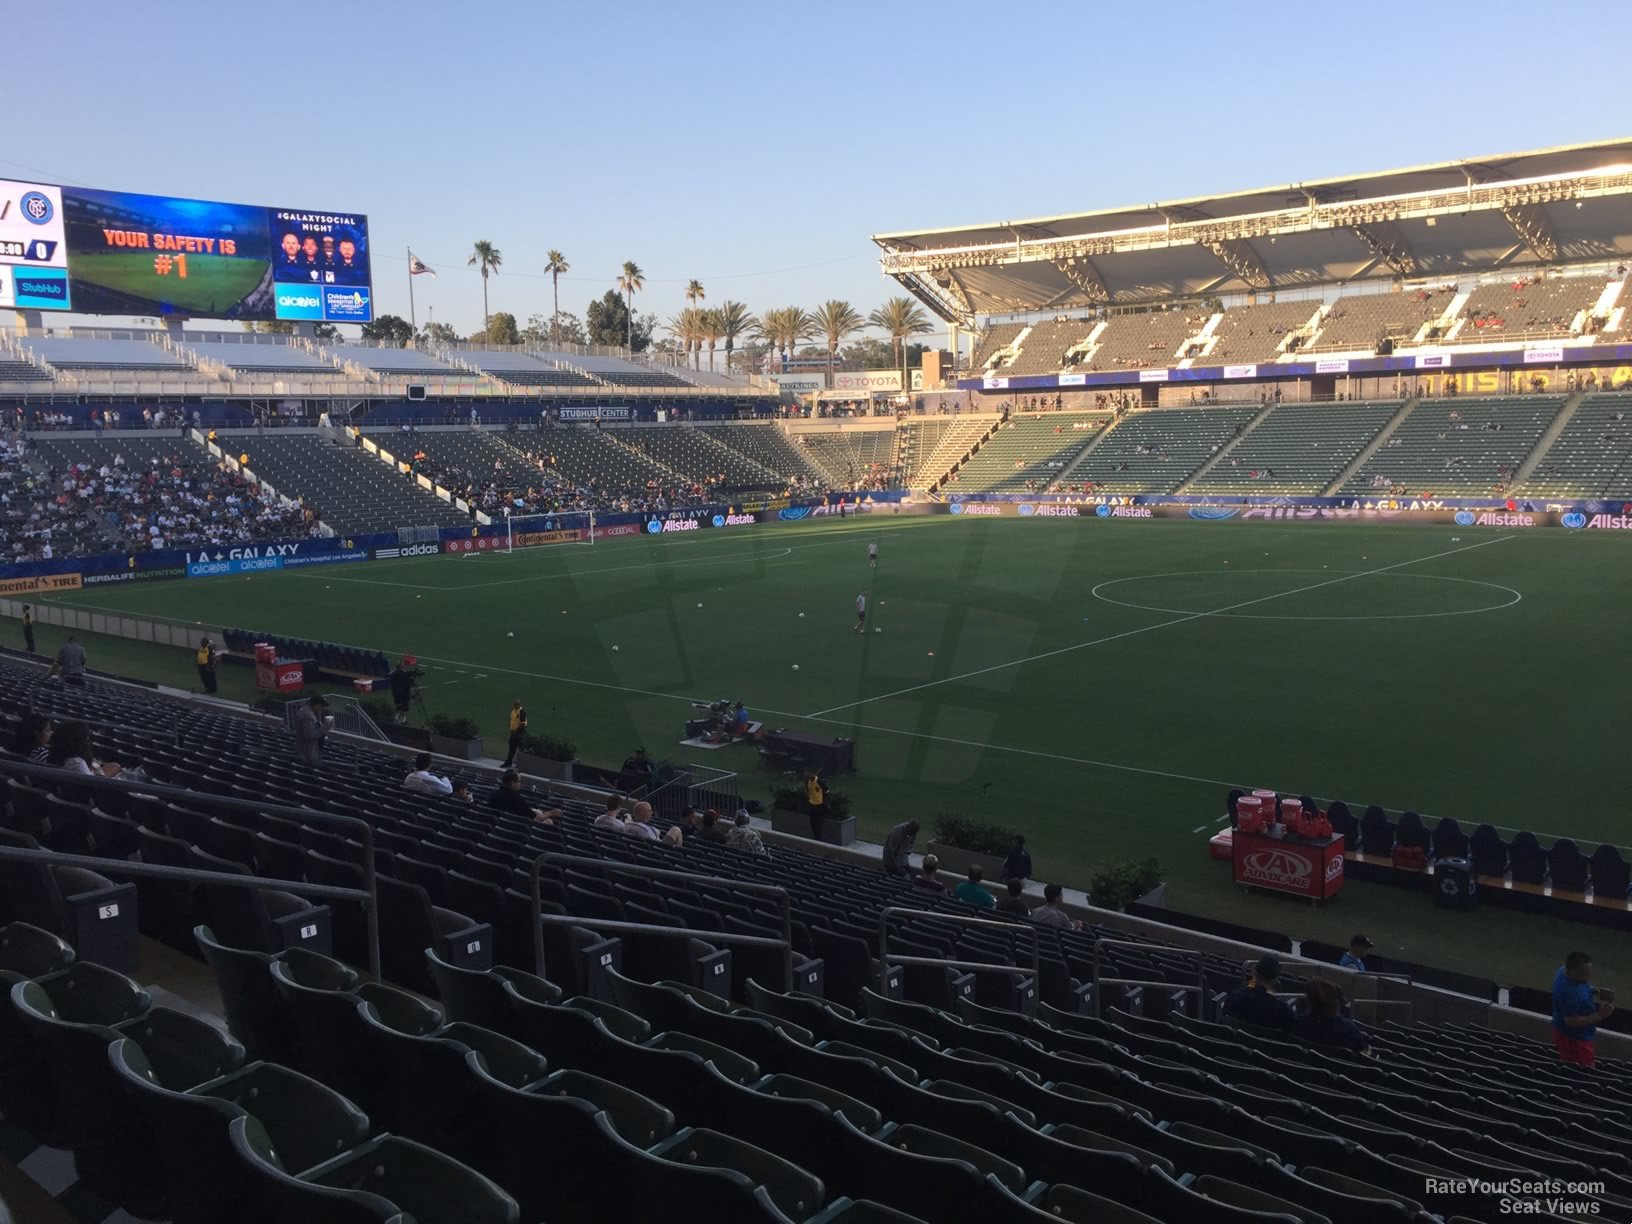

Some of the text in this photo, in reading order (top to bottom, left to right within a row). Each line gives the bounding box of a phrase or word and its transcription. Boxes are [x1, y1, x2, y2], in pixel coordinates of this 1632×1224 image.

[278, 212, 356, 225] #GALAXYSOCIAL
[302, 223, 333, 233] NIGHT
[103, 229, 236, 256] YOUR SAFETY IS
[35, 242, 47, 260] 0
[154, 253, 188, 279] #1
[22, 282, 61, 293] StubHub
[854, 376, 899, 387] TOYOTA
[560, 408, 629, 418] STUBHUB CENTER
[229, 543, 299, 561] GALAXY
[401, 543, 438, 557] adidas
[192, 558, 277, 575] alcatel alcatel
[52, 576, 79, 587] TIRE
[84, 568, 185, 584] HERBALIFE NUTRITION
[106, 907, 112, 917] S
[306, 927, 313, 937] R
